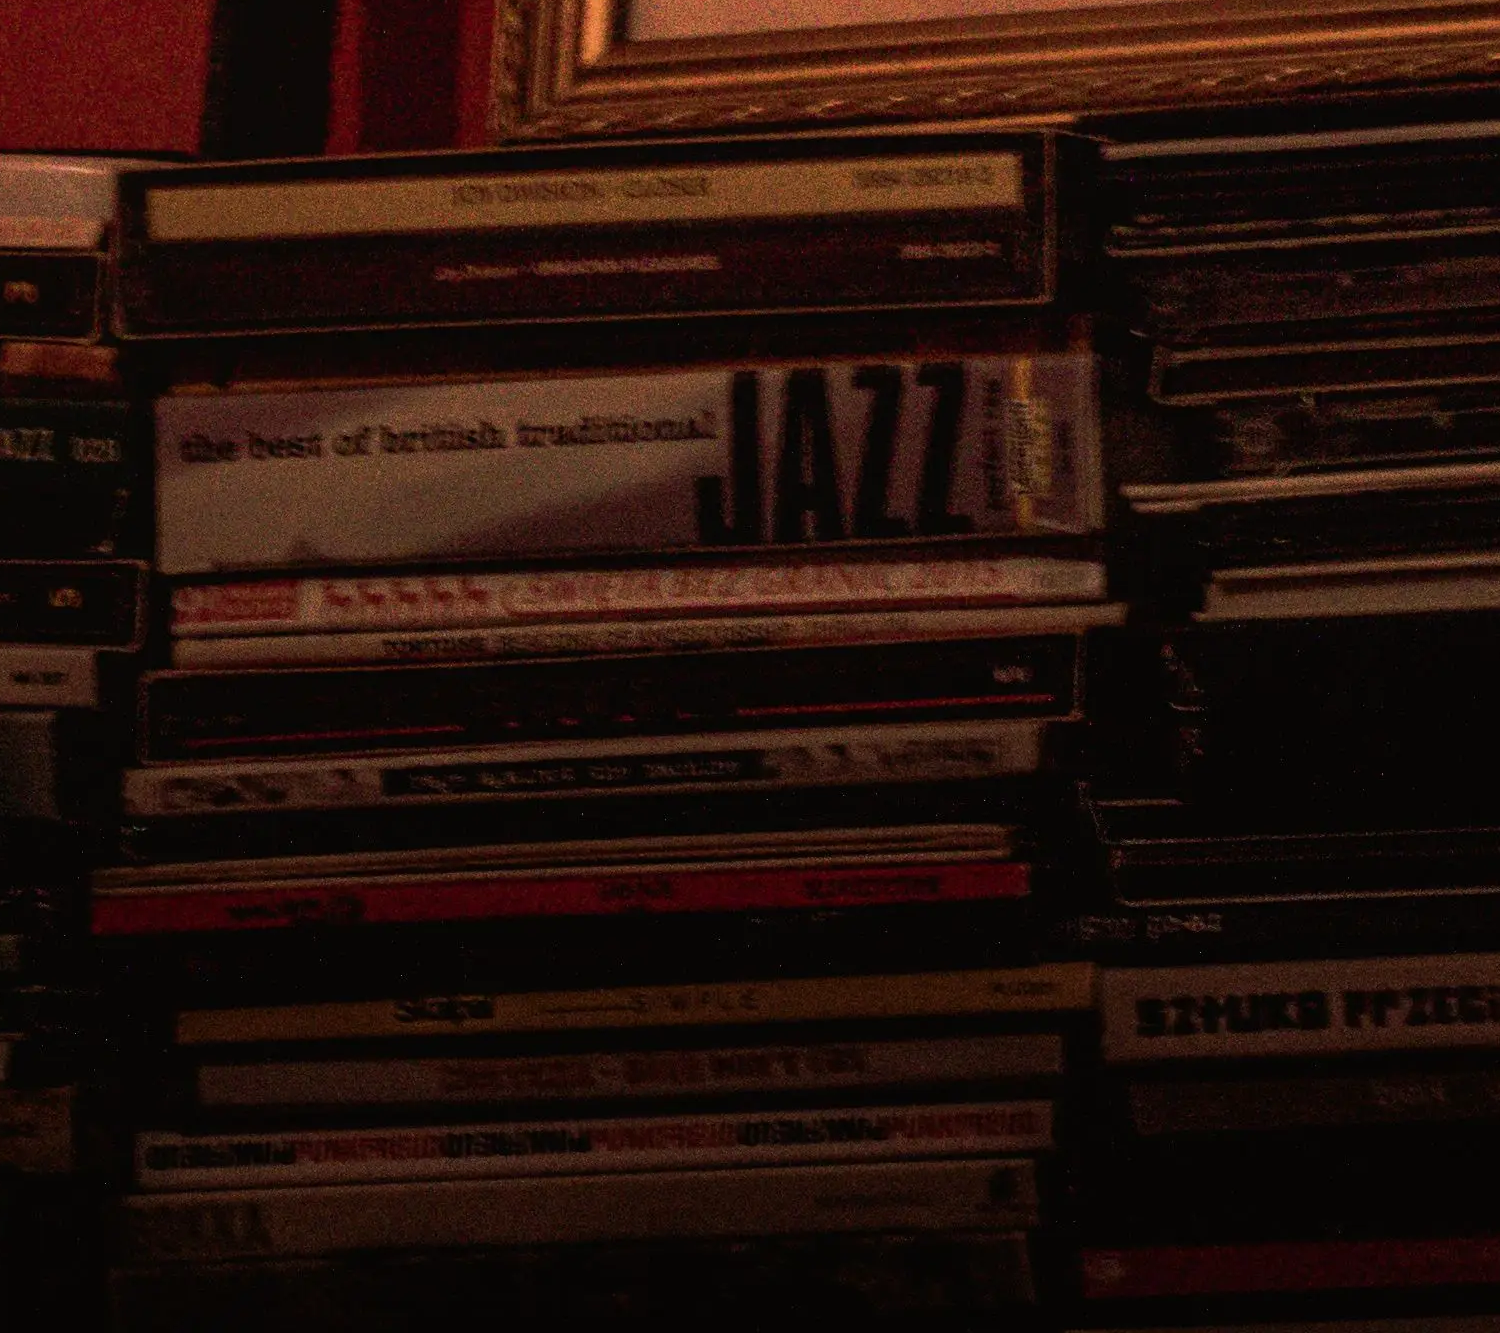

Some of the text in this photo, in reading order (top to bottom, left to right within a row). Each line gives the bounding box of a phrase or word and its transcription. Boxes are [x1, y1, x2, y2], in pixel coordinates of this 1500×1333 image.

[181, 407, 716, 464] the best of british traditional
[694, 363, 972, 544] JAZZ
